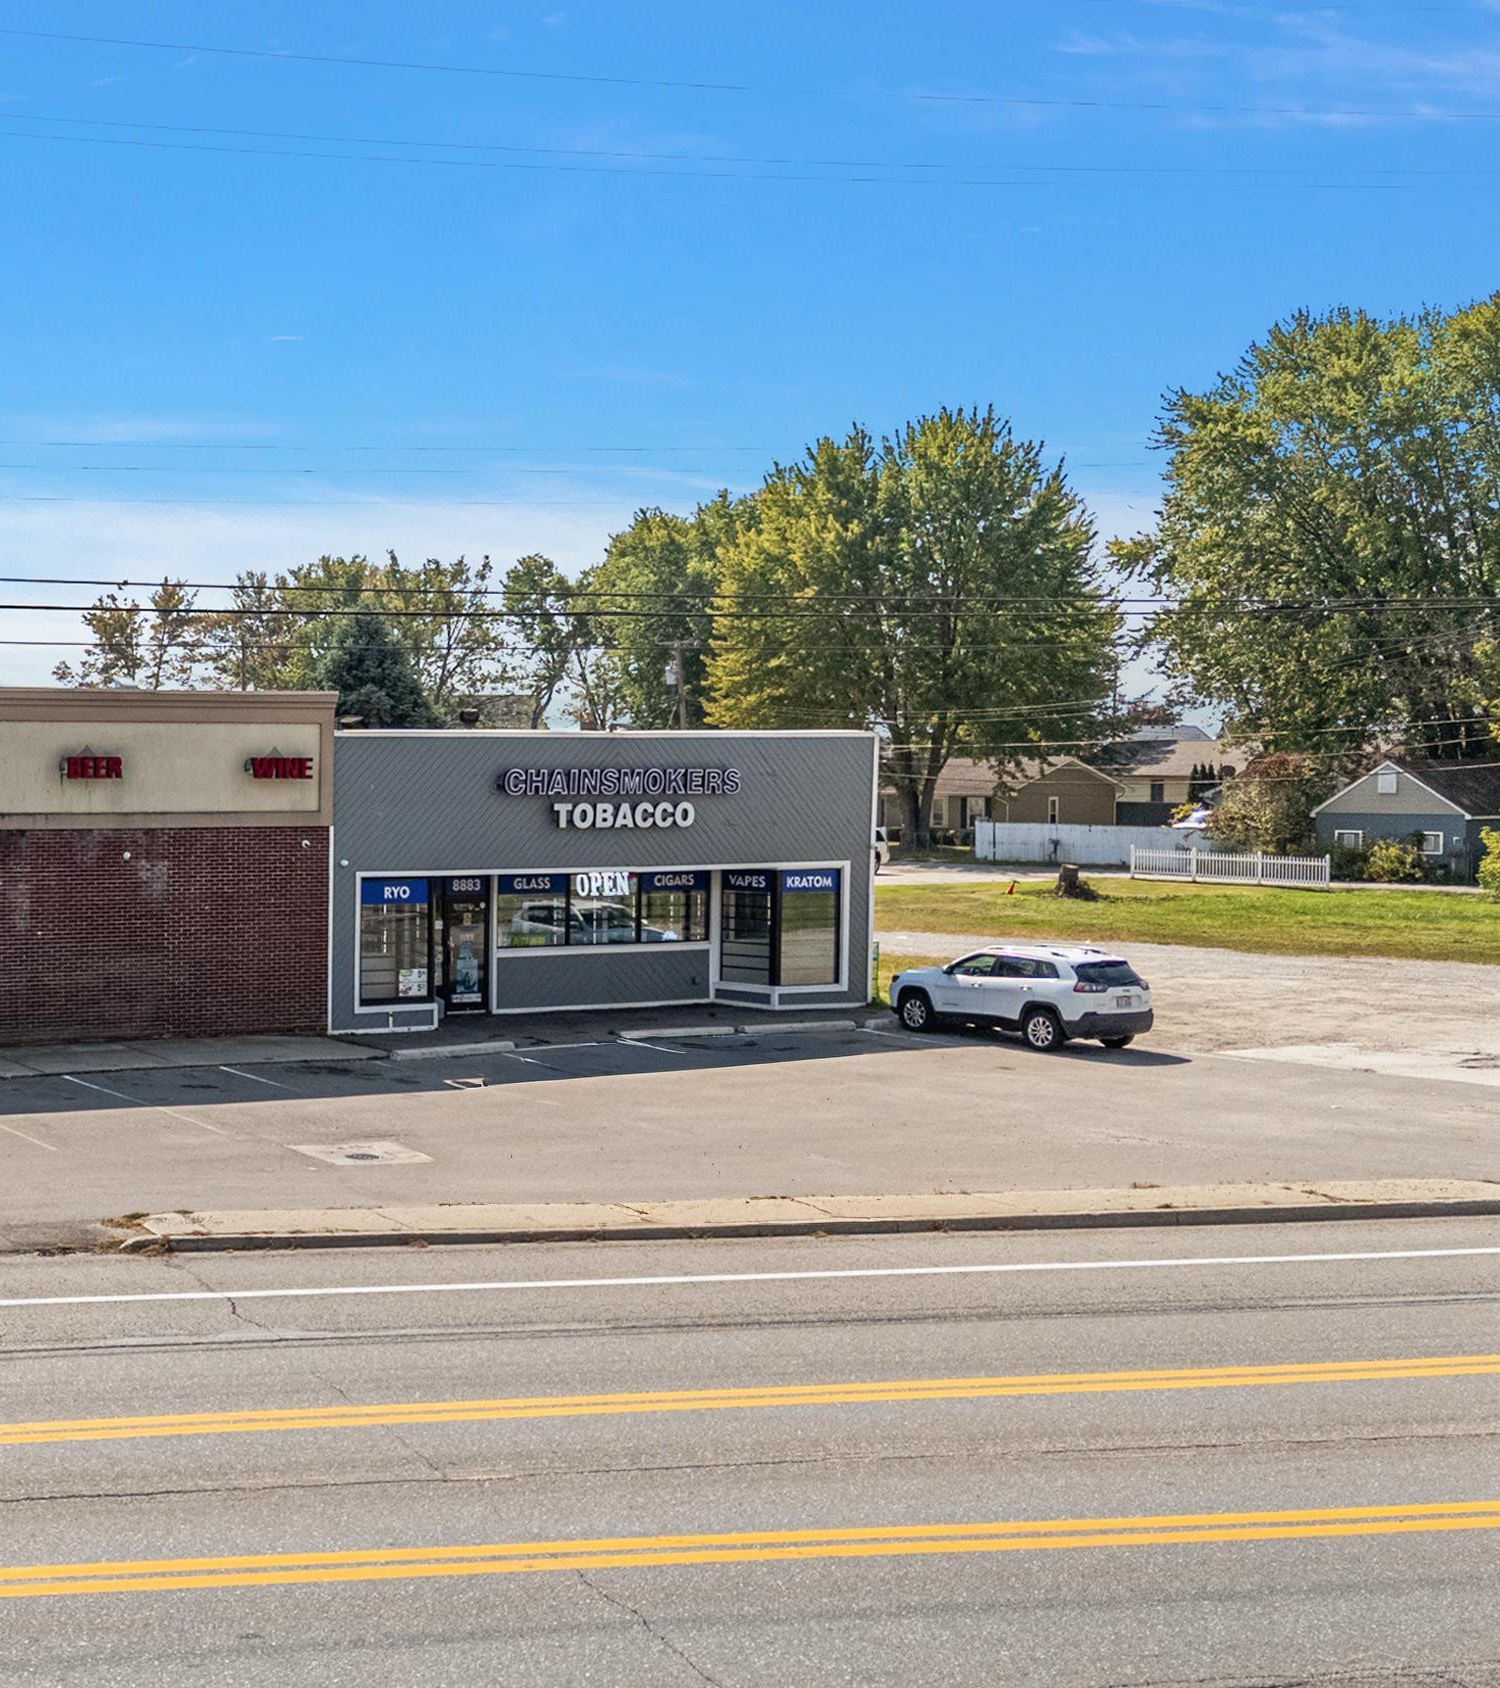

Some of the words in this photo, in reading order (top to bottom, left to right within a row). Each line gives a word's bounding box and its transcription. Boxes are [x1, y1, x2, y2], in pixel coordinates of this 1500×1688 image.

[67, 756, 122, 778] BEER
[251, 757, 313, 779] WINE
[504, 768, 741, 795] CHAINSMOKERS
[553, 802, 695, 829] TOBACCO
[452, 879, 481, 891] 8883
[513, 877, 551, 890] GLASS
[576, 872, 630, 897] OPEN
[654, 875, 694, 887] CIGARS
[729, 875, 766, 888] VAPES
[786, 876, 832, 888] KRATOM
[384, 886, 410, 899] RYO
